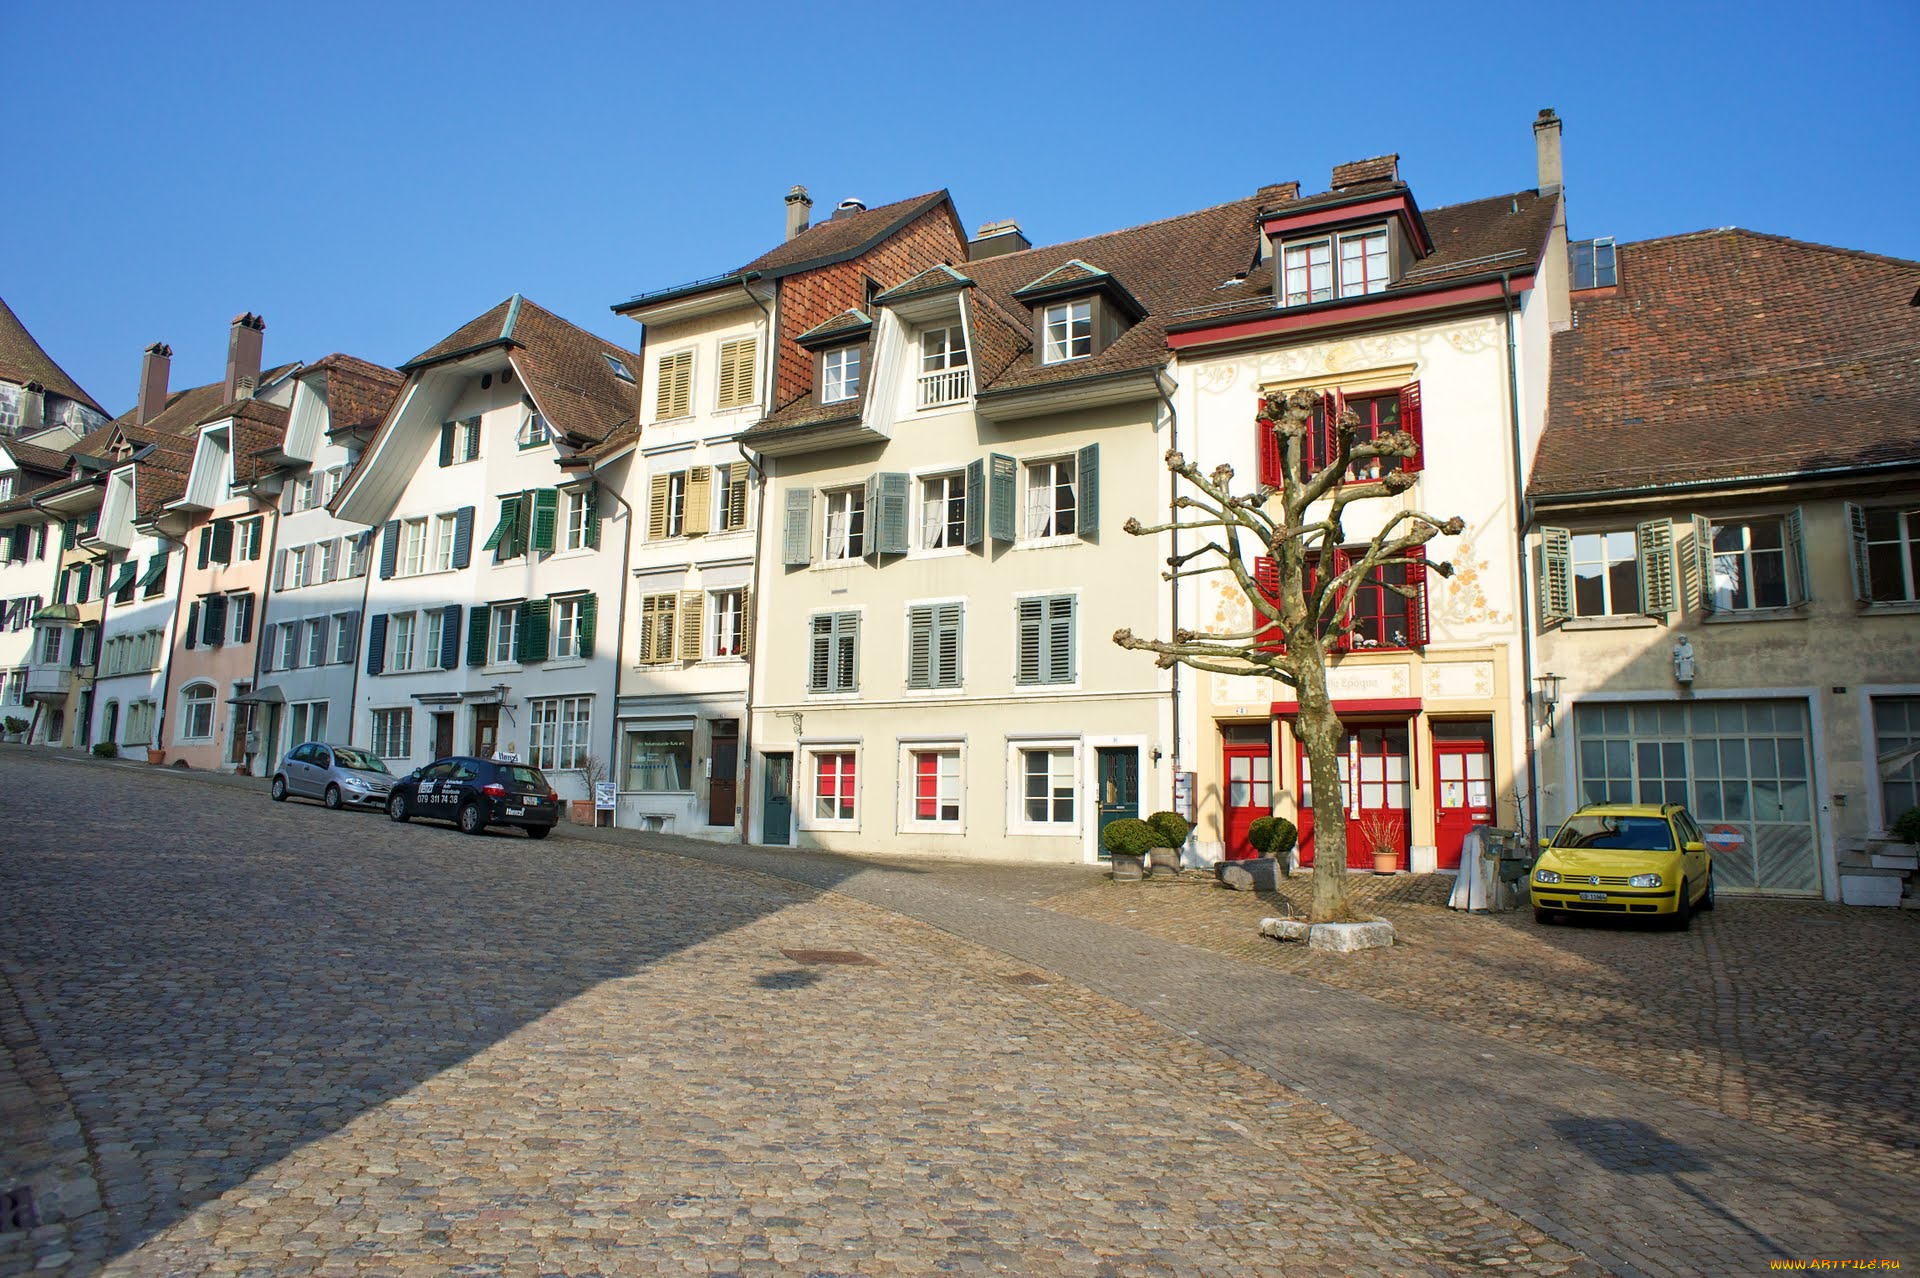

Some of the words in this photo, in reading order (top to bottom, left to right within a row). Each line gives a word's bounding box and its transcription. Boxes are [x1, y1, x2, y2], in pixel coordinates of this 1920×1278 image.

[417, 795, 429, 803] 079
[430, 795, 440, 803] 311
[441, 795, 448, 804] 74
[449, 795, 459, 804] 38
